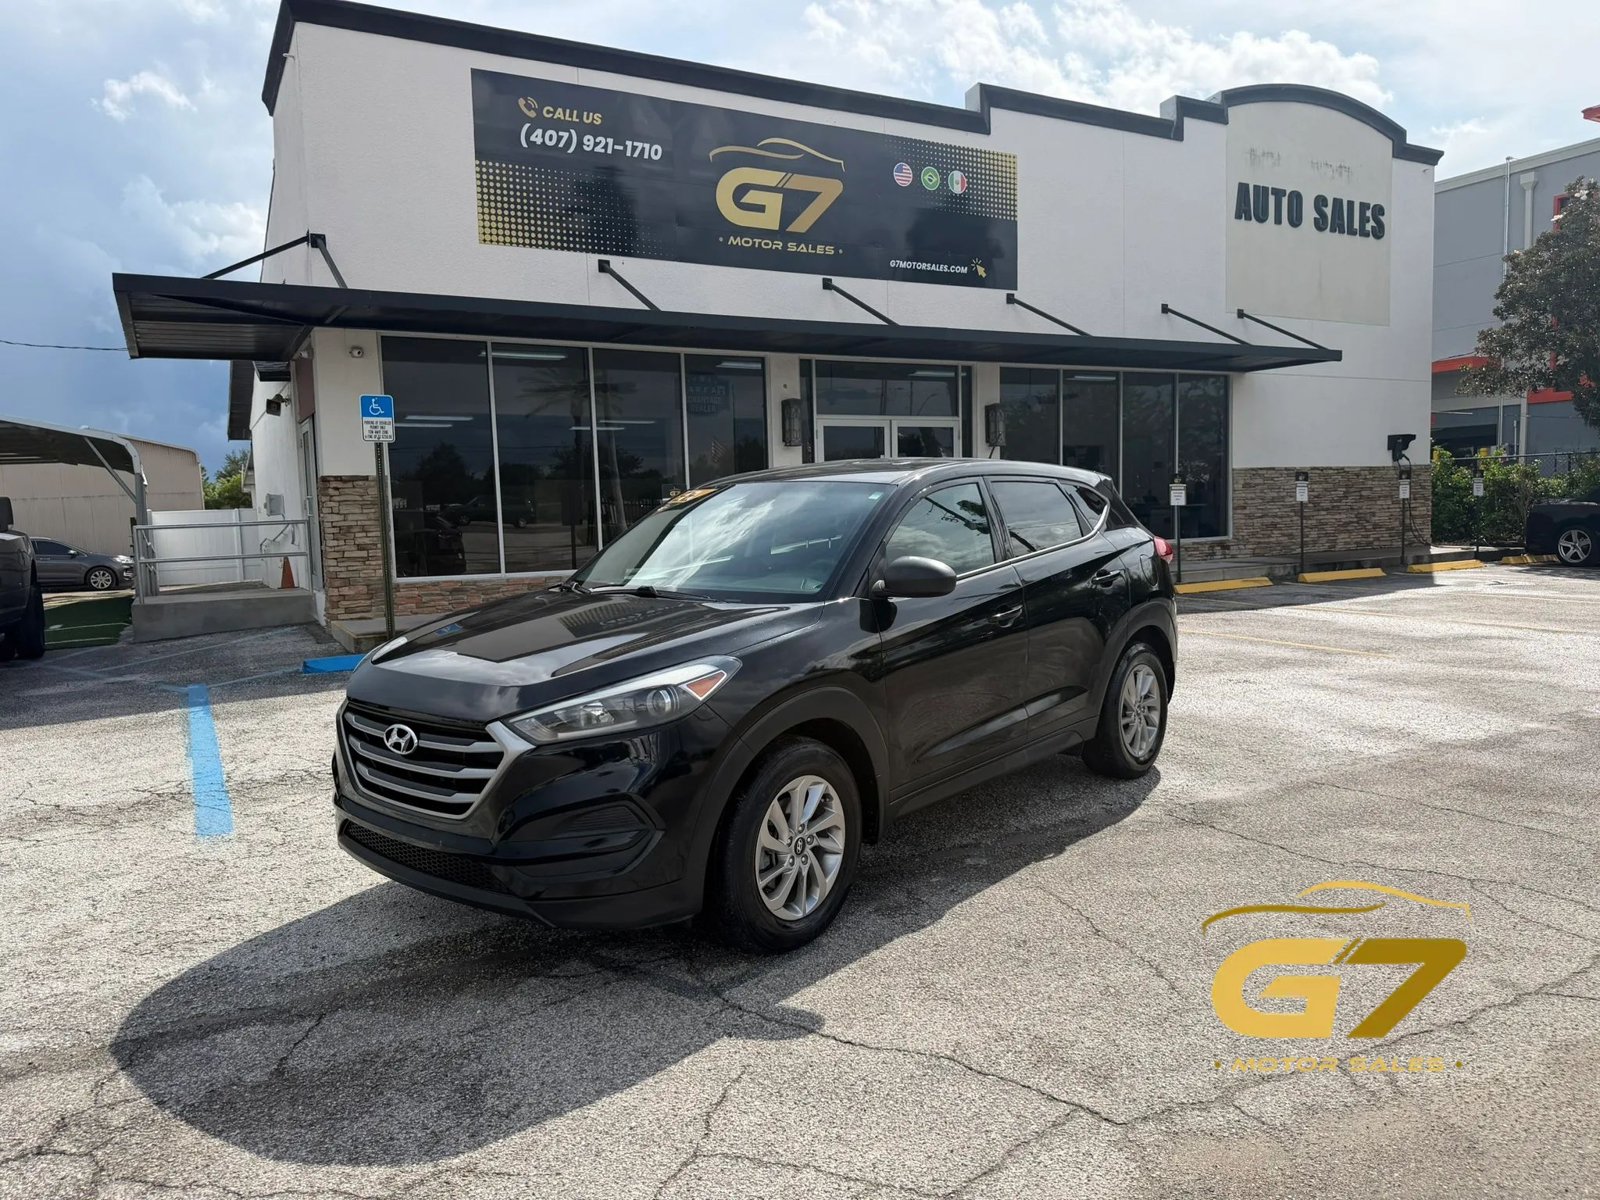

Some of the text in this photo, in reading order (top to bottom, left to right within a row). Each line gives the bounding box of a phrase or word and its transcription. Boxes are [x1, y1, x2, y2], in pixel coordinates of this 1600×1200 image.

[542, 106, 603, 125] CALL US
[520, 123, 663, 161] (407) 921-1710
[715, 167, 844, 233] G7
[1234, 182, 1385, 240] AUTO SALES
[727, 235, 835, 255] MOTOR SALES
[889, 259, 968, 274] G7MOTORSALES.COM
